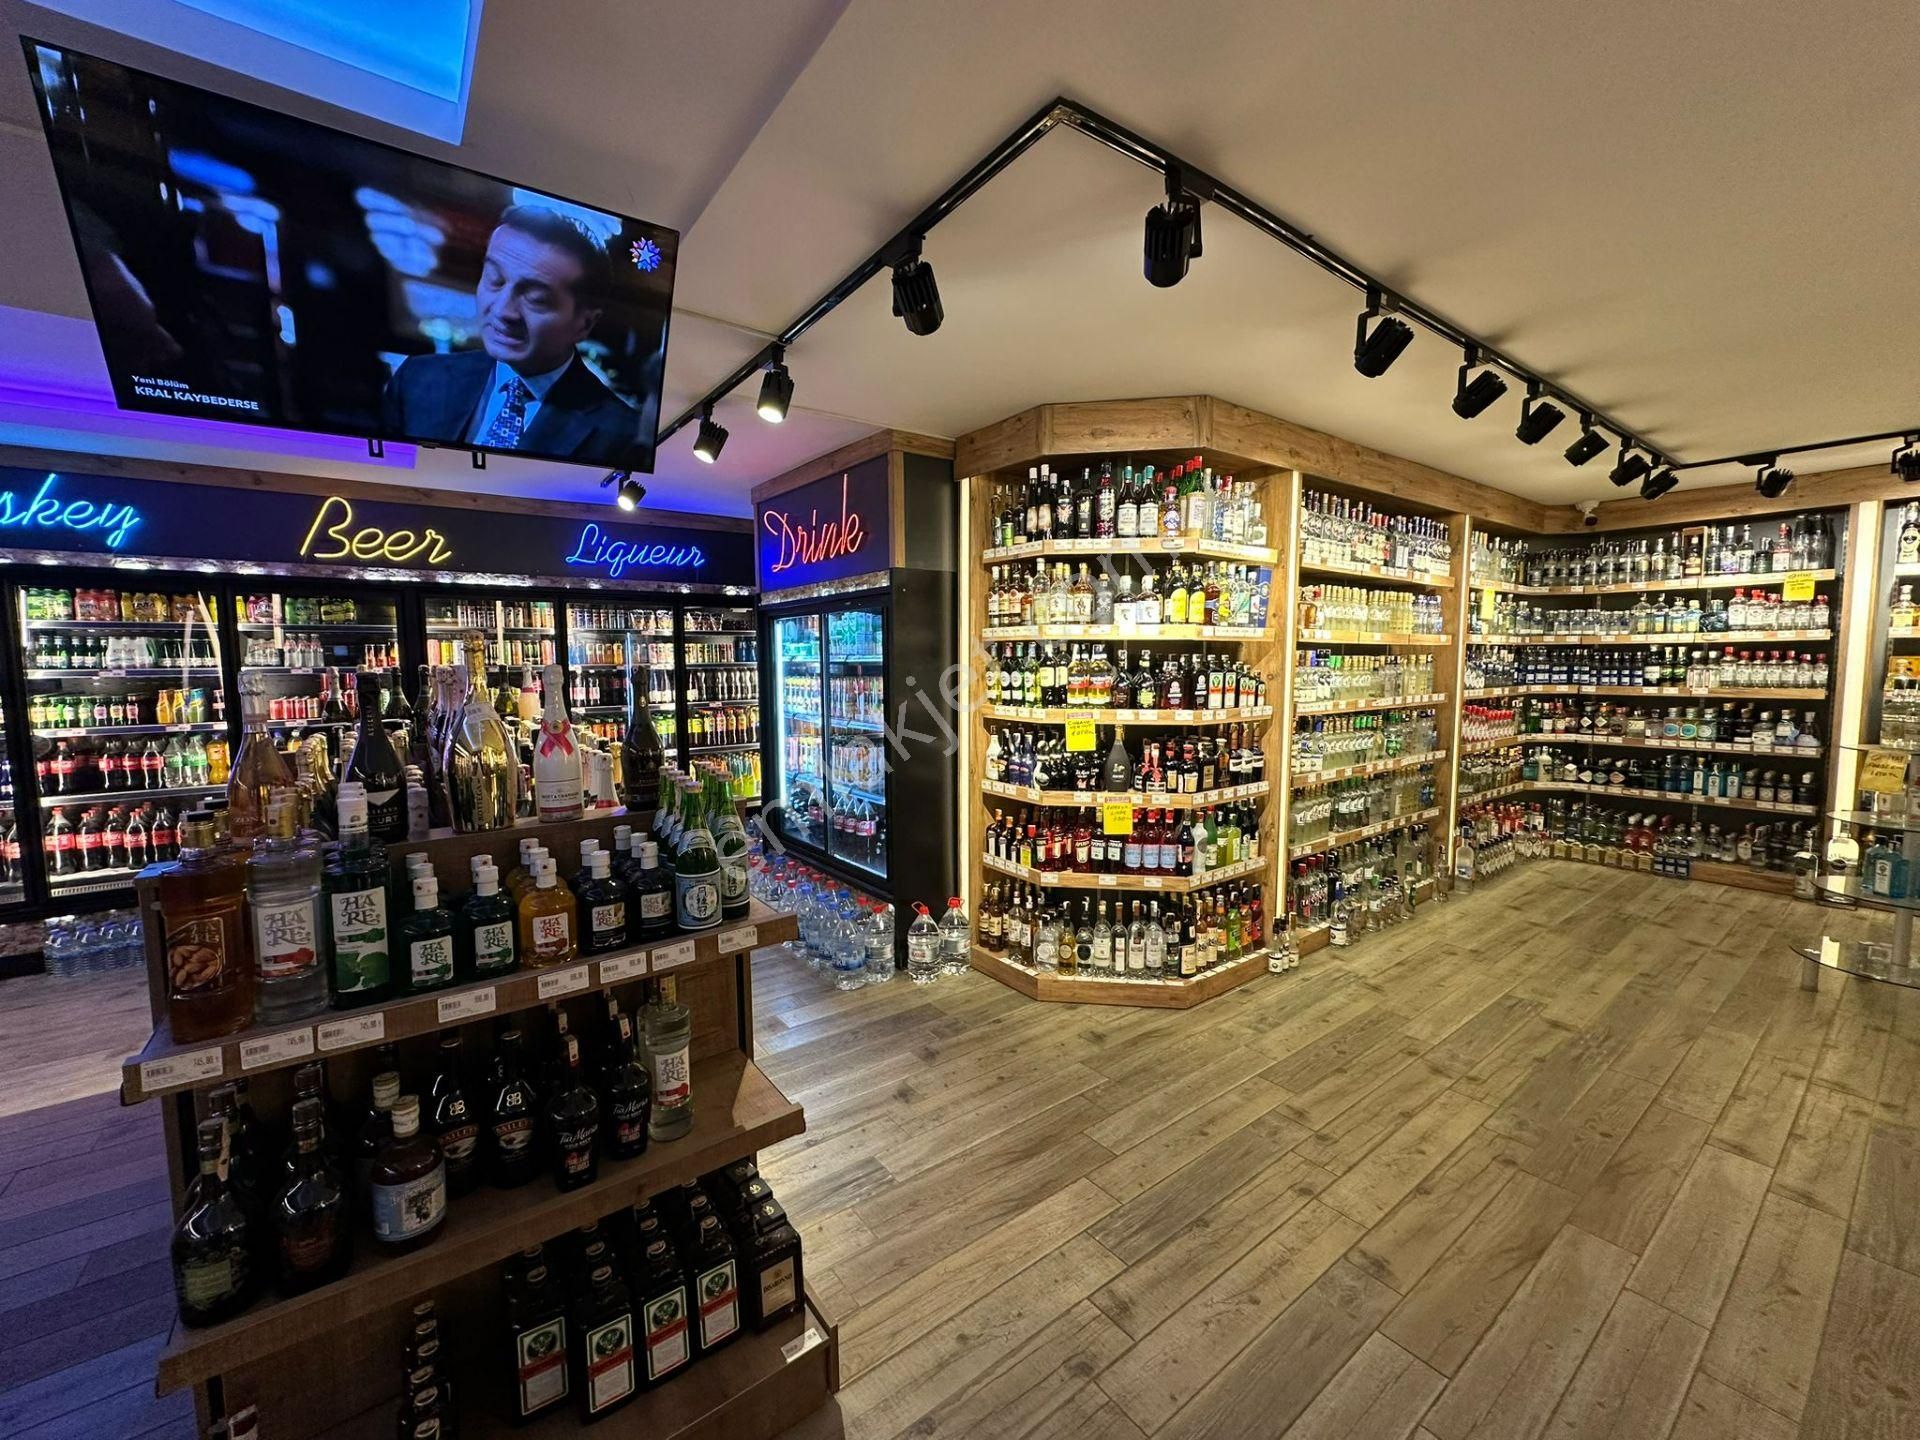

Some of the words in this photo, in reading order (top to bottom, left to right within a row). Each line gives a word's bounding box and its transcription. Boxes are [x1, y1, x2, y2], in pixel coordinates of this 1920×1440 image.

[131, 375, 156, 385] Yeni
[156, 378, 189, 389] Bölüm
[134, 385, 172, 399] KRAL
[174, 391, 260, 410] KAYBEDERSE
[300, 496, 453, 564] Beer
[565, 523, 705, 578] Liqueur
[763, 473, 864, 573] Drink
